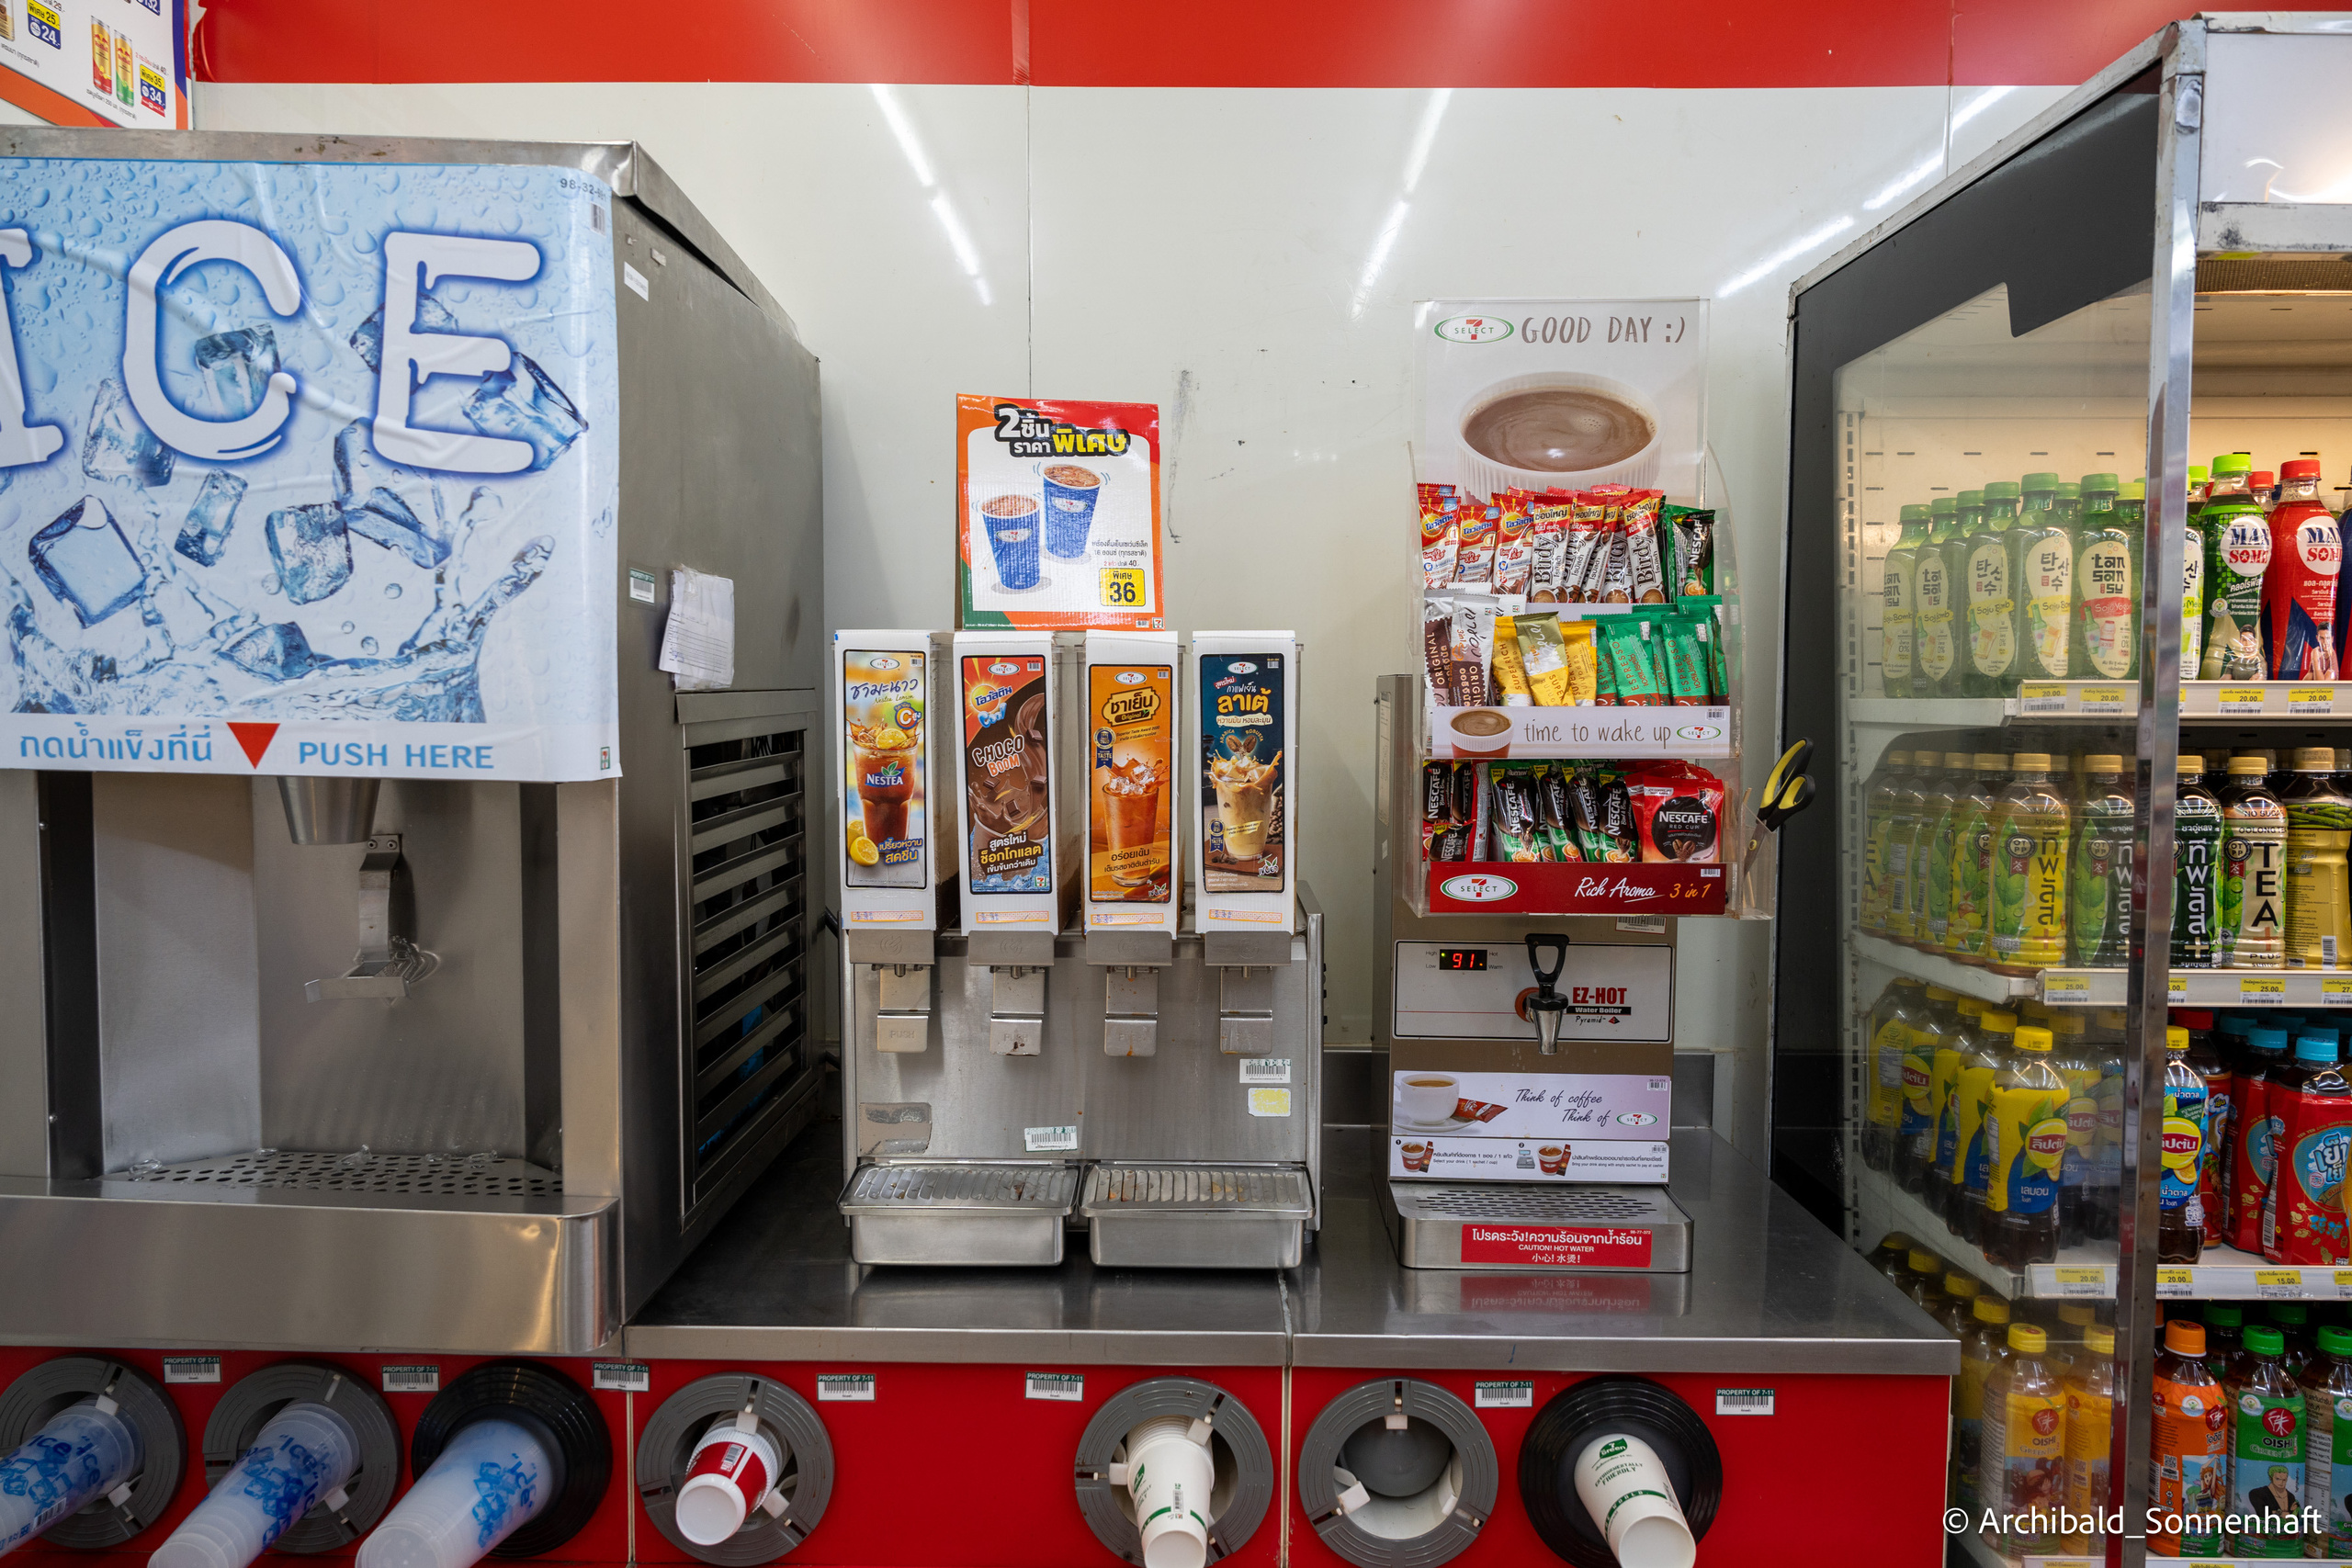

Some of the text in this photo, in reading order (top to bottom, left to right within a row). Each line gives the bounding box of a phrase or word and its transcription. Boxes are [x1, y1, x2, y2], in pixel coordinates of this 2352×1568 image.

[1454, 326, 1495, 334] SELECT
[1521, 316, 1592, 344] GOOD
[1608, 316, 1653, 344] DAY
[1533, 535, 1560, 586] Birdy
[1633, 535, 1657, 587] Birdy
[1113, 570, 1132, 580] พิเศษ
[1427, 632, 1445, 685] ORIGINAL
[1499, 643, 1522, 690] SUPER RICH
[1611, 641, 1640, 691] ESPRESSO
[1668, 639, 1691, 692] ESPRESSO
[851, 678, 919, 700] ชามะนาว
[975, 686, 1012, 706] โอวัลติน
[1111, 692, 1153, 715] ชาเย็น
[1217, 687, 1272, 713] ลาเต้
[1121, 712, 1142, 721] Original
[20, 721, 212, 761] กดน้ำแข็งที่นี่
[1523, 718, 1562, 742] time
[1571, 722, 1589, 742] to
[1598, 718, 1643, 742] wake
[1653, 724, 1671, 750] up
[300, 742, 494, 770] PUSH HERE
[972, 734, 1024, 767] CHOCO
[987, 753, 1021, 777] BOOM
[866, 773, 903, 785] NESTEA
[879, 838, 922, 851] เปรี้ยวหวาน
[989, 831, 1027, 852] สูตรใหม่
[885, 846, 918, 863] สดชื่น
[980, 845, 1042, 864] ช็อกโกแลต
[1111, 847, 1150, 861] อร่อยเข้ม
[987, 858, 1036, 874] เข้มข้นกว่าเดิม
[1460, 877, 1712, 898] SELECT Rich Aroma 3 in 1
[1573, 987, 1628, 1004] EZ-HOT
[1515, 1089, 1603, 1109] Think of coffee
[1562, 1108, 1593, 1122] Think
[1597, 1110, 1611, 1127] of
[1518, 1244, 1553, 1252] CAUTION!
[1027, 1372, 1060, 1381] PROPERTY
[2031, 1435, 2056, 1447] OISHI
[2262, 1437, 2293, 1449] OISHI
